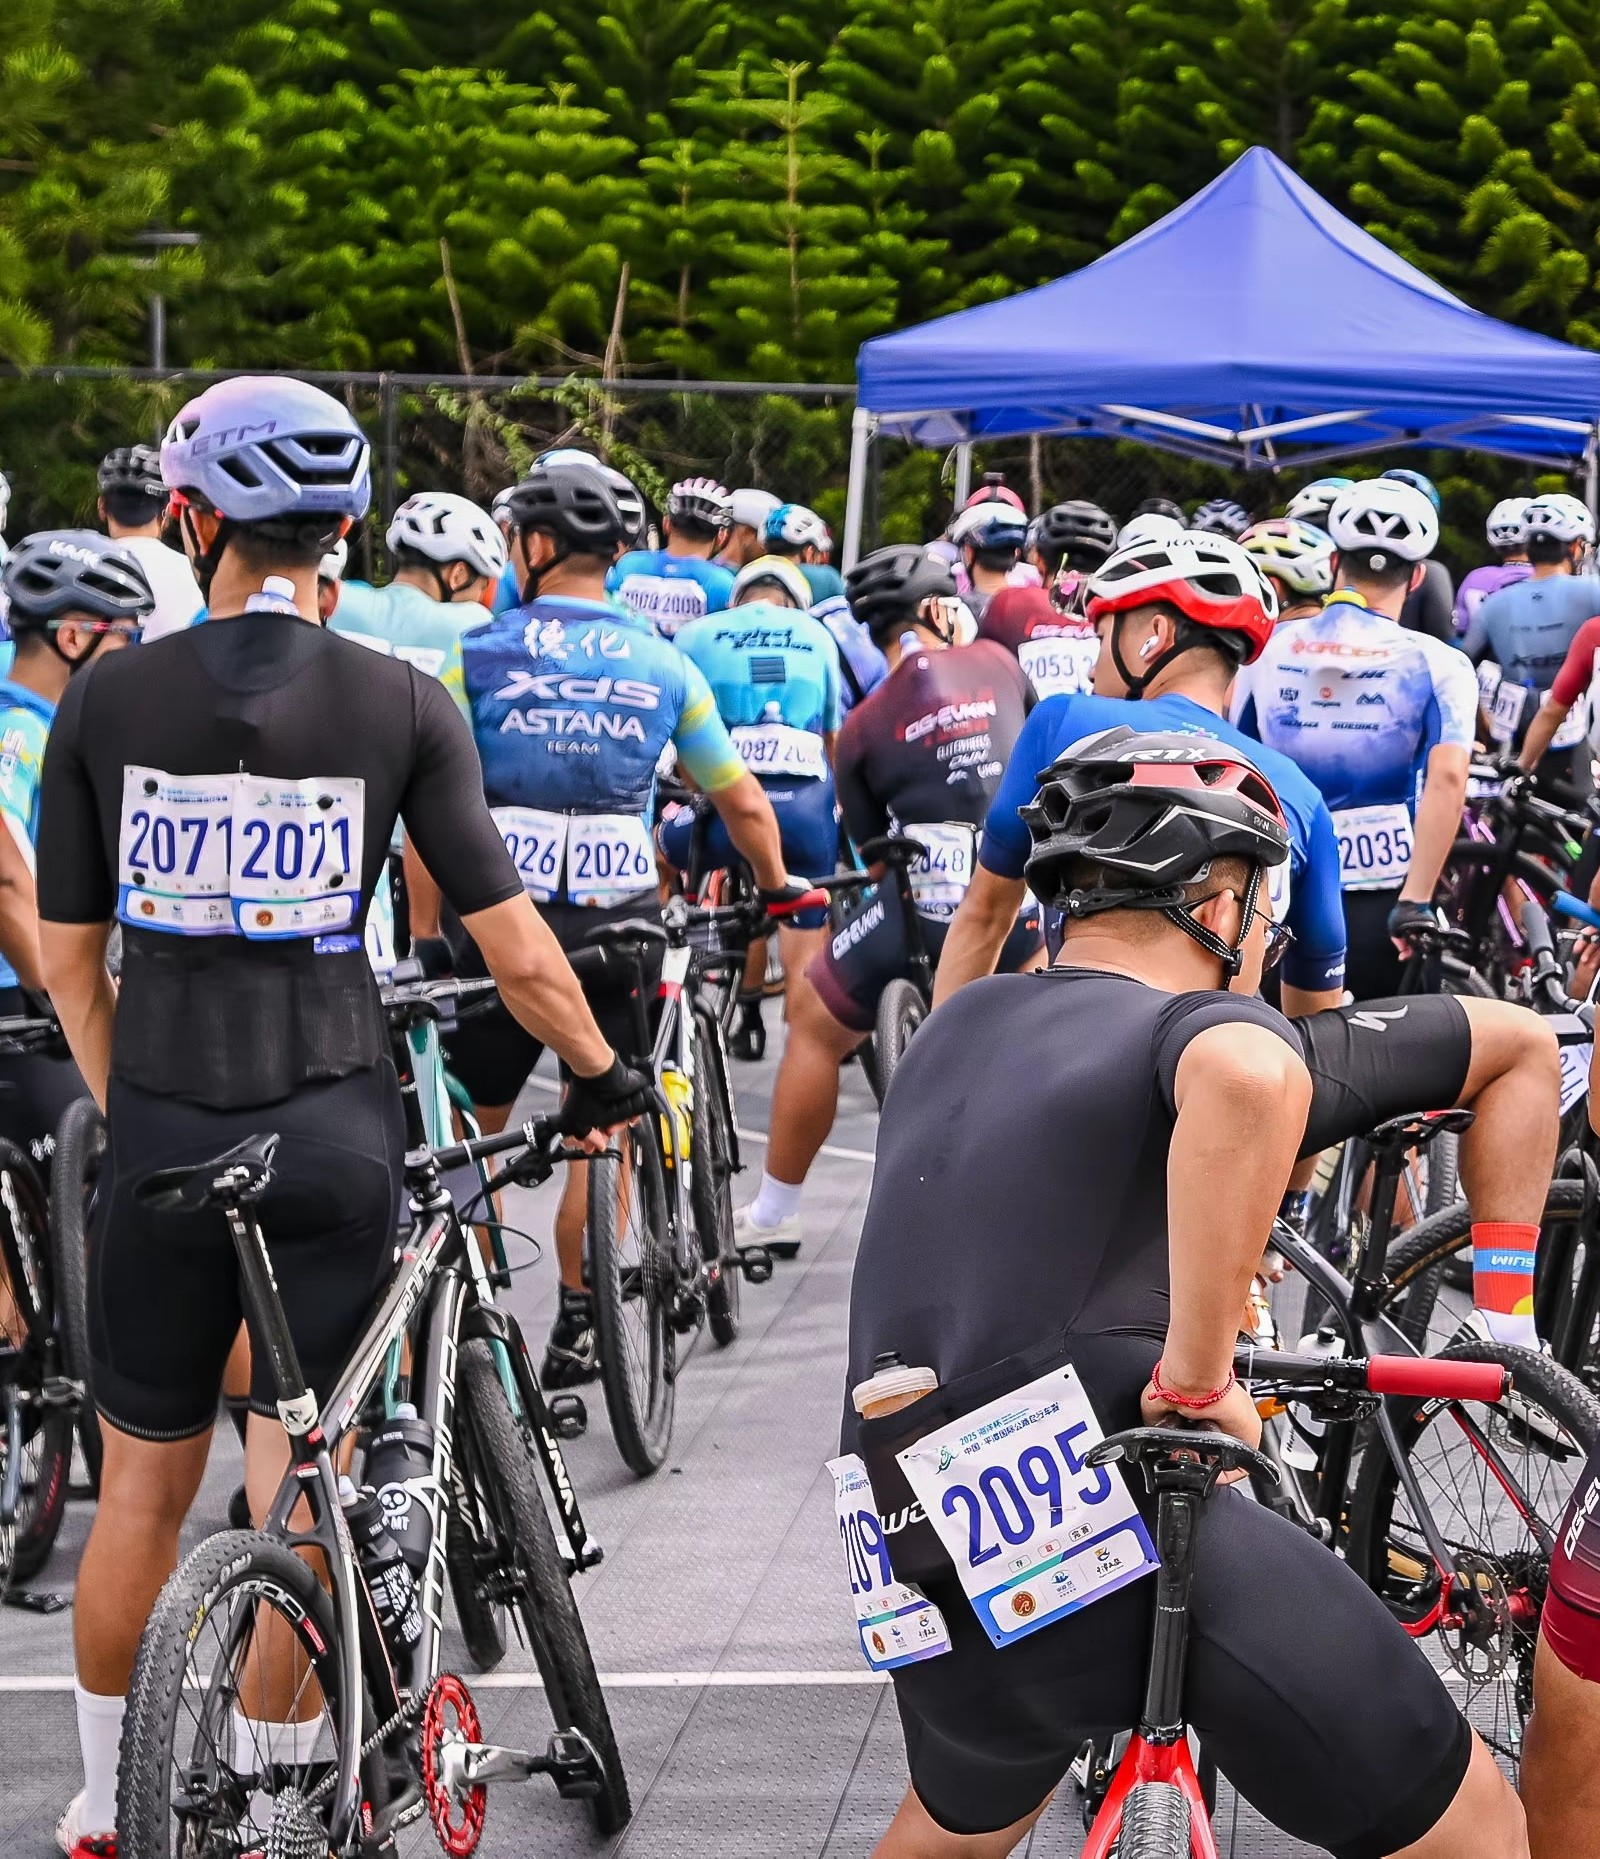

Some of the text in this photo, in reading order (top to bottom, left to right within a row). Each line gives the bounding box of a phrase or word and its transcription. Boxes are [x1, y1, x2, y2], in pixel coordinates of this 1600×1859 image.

[500, 707, 648, 744] ASTANA
[547, 740, 601, 755] TEAM
[129, 809, 351, 881] 2071 2071
[505, 834, 649, 878] 026 2026
[1339, 828, 1411, 870] 2035
[959, 1431, 978, 1447] 2025
[942, 1420, 1113, 1569] 2095
